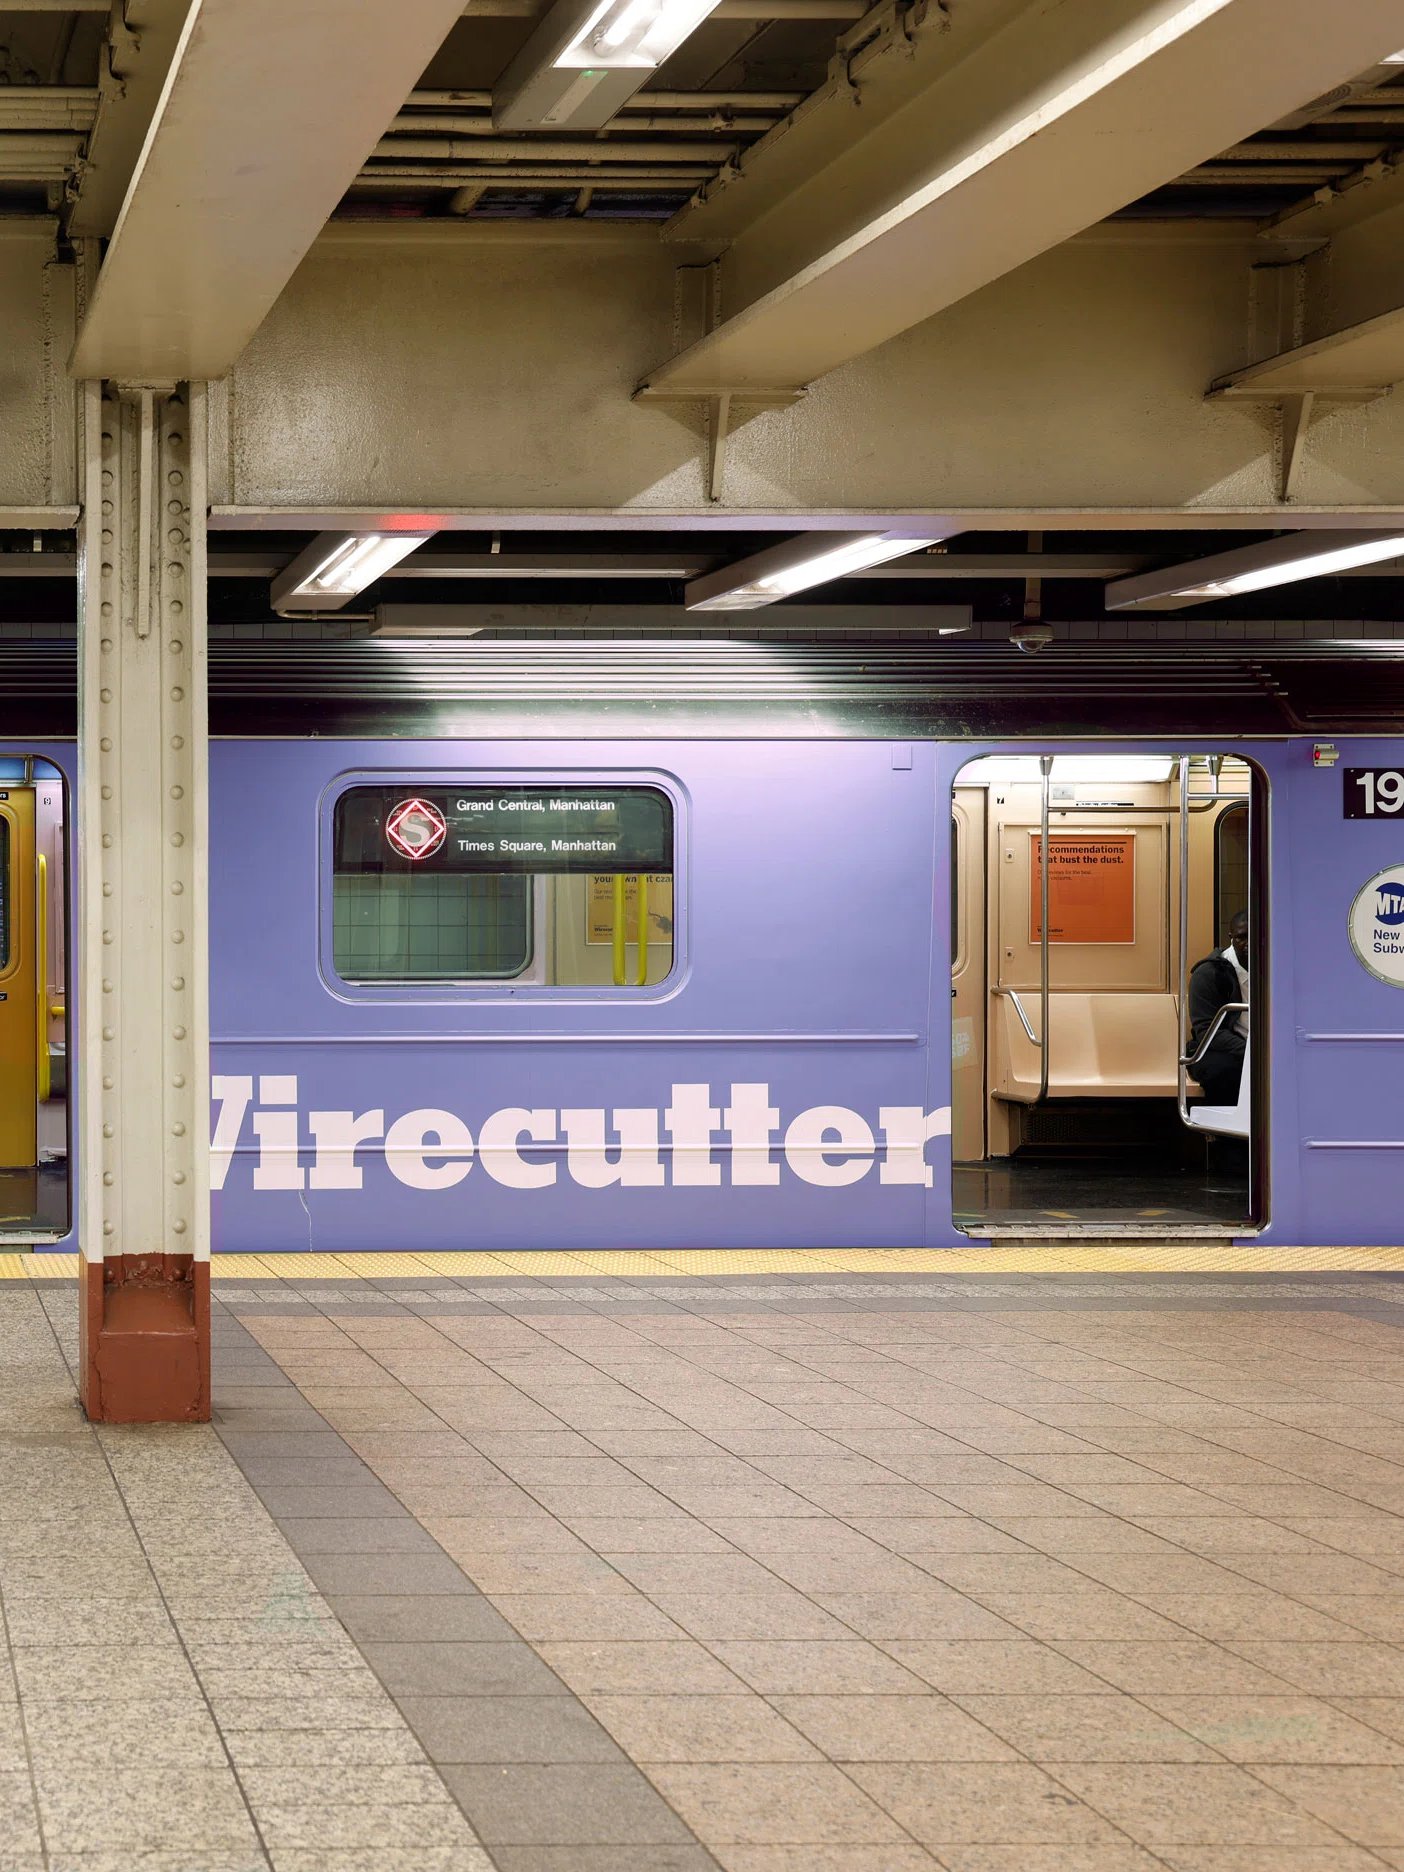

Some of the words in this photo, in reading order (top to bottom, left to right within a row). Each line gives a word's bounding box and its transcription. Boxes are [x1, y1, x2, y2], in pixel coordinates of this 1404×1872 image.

[1356, 771, 1404, 814] 19
[456, 799, 493, 811] Grand
[498, 799, 545, 813] Central,
[549, 799, 615, 811] Manhattan
[457, 840, 495, 851] Times
[499, 839, 547, 853] Square,
[551, 840, 616, 851] Manhattan
[1037, 856, 1057, 864] tat
[1060, 856, 1081, 864] bust
[1083, 856, 1098, 864] the
[1100, 856, 1124, 864] dust.
[1373, 929, 1400, 940] New
